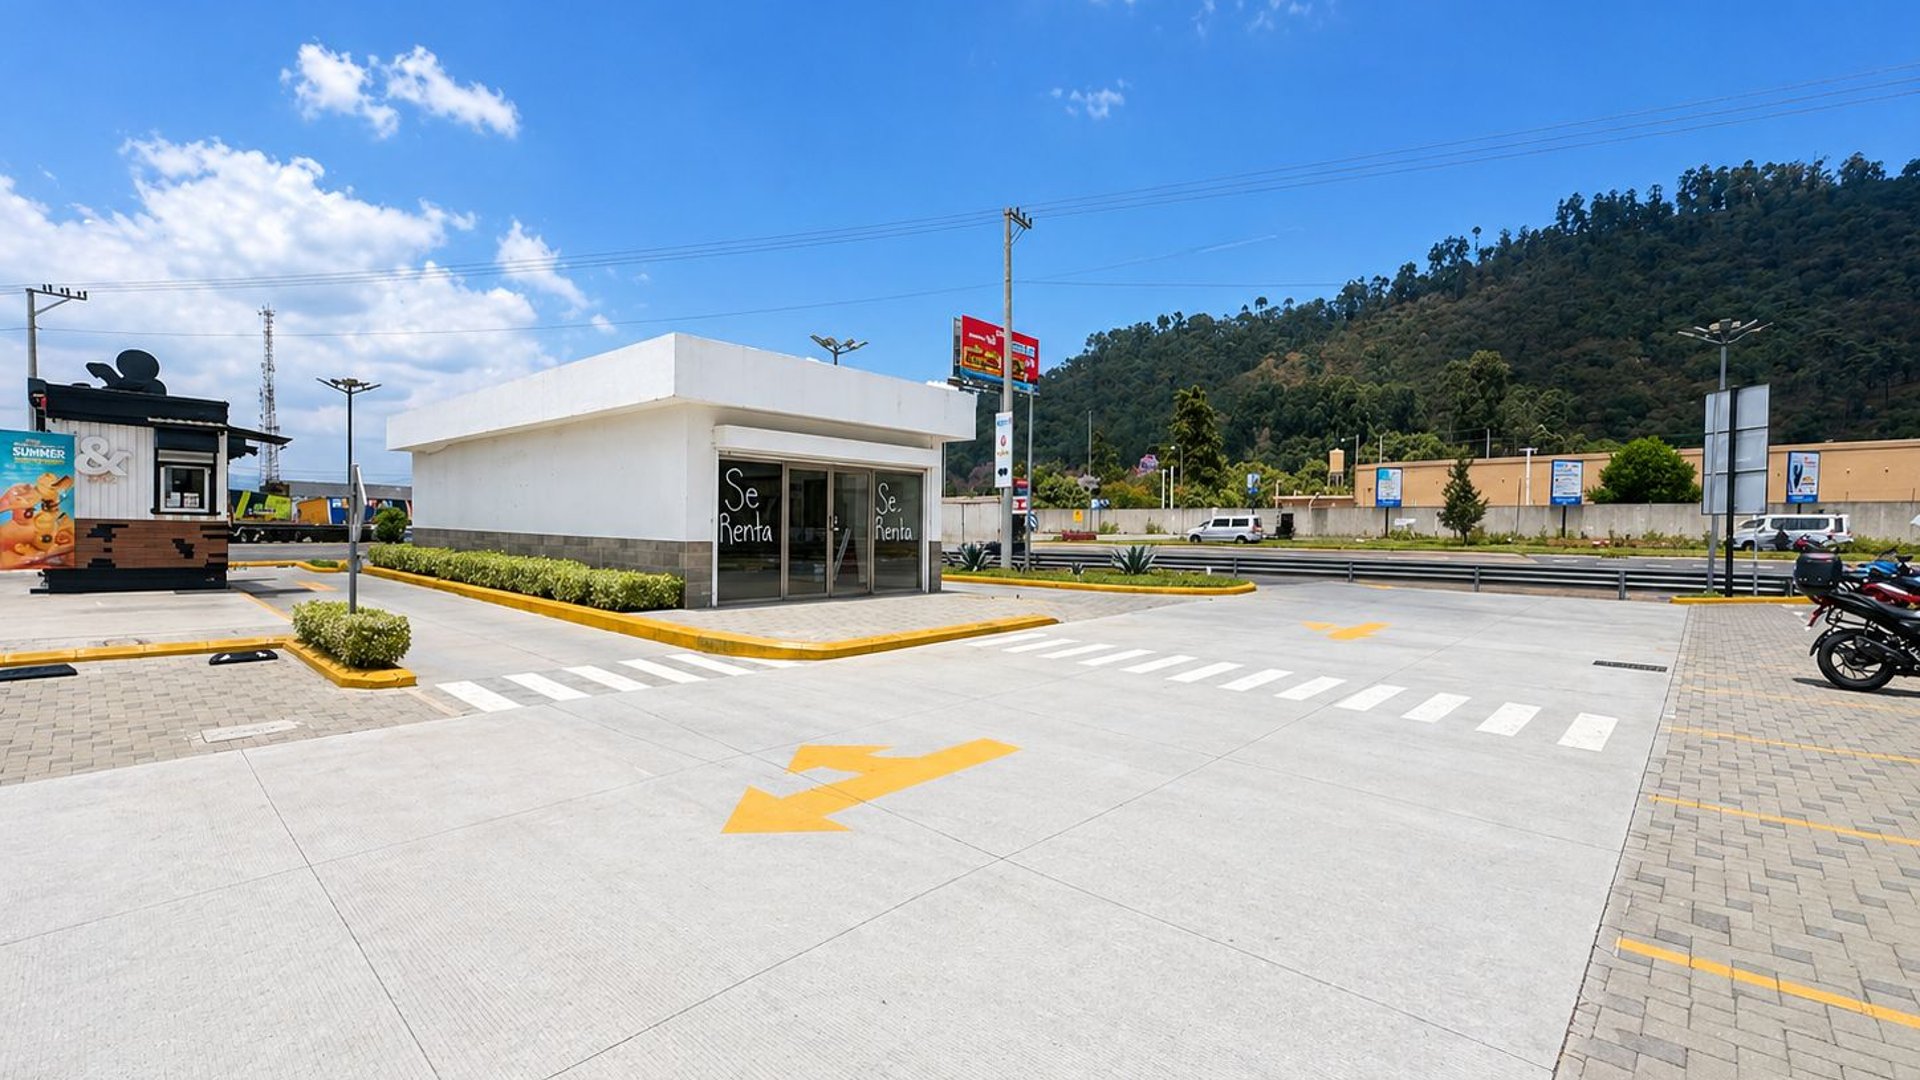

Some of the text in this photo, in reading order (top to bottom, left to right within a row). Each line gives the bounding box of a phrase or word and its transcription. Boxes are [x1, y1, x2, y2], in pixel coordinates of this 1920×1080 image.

[12, 446, 66, 460] SUMMER
[724, 467, 760, 512] Se
[719, 511, 773, 545] Renta
[875, 515, 913, 542] Renta
